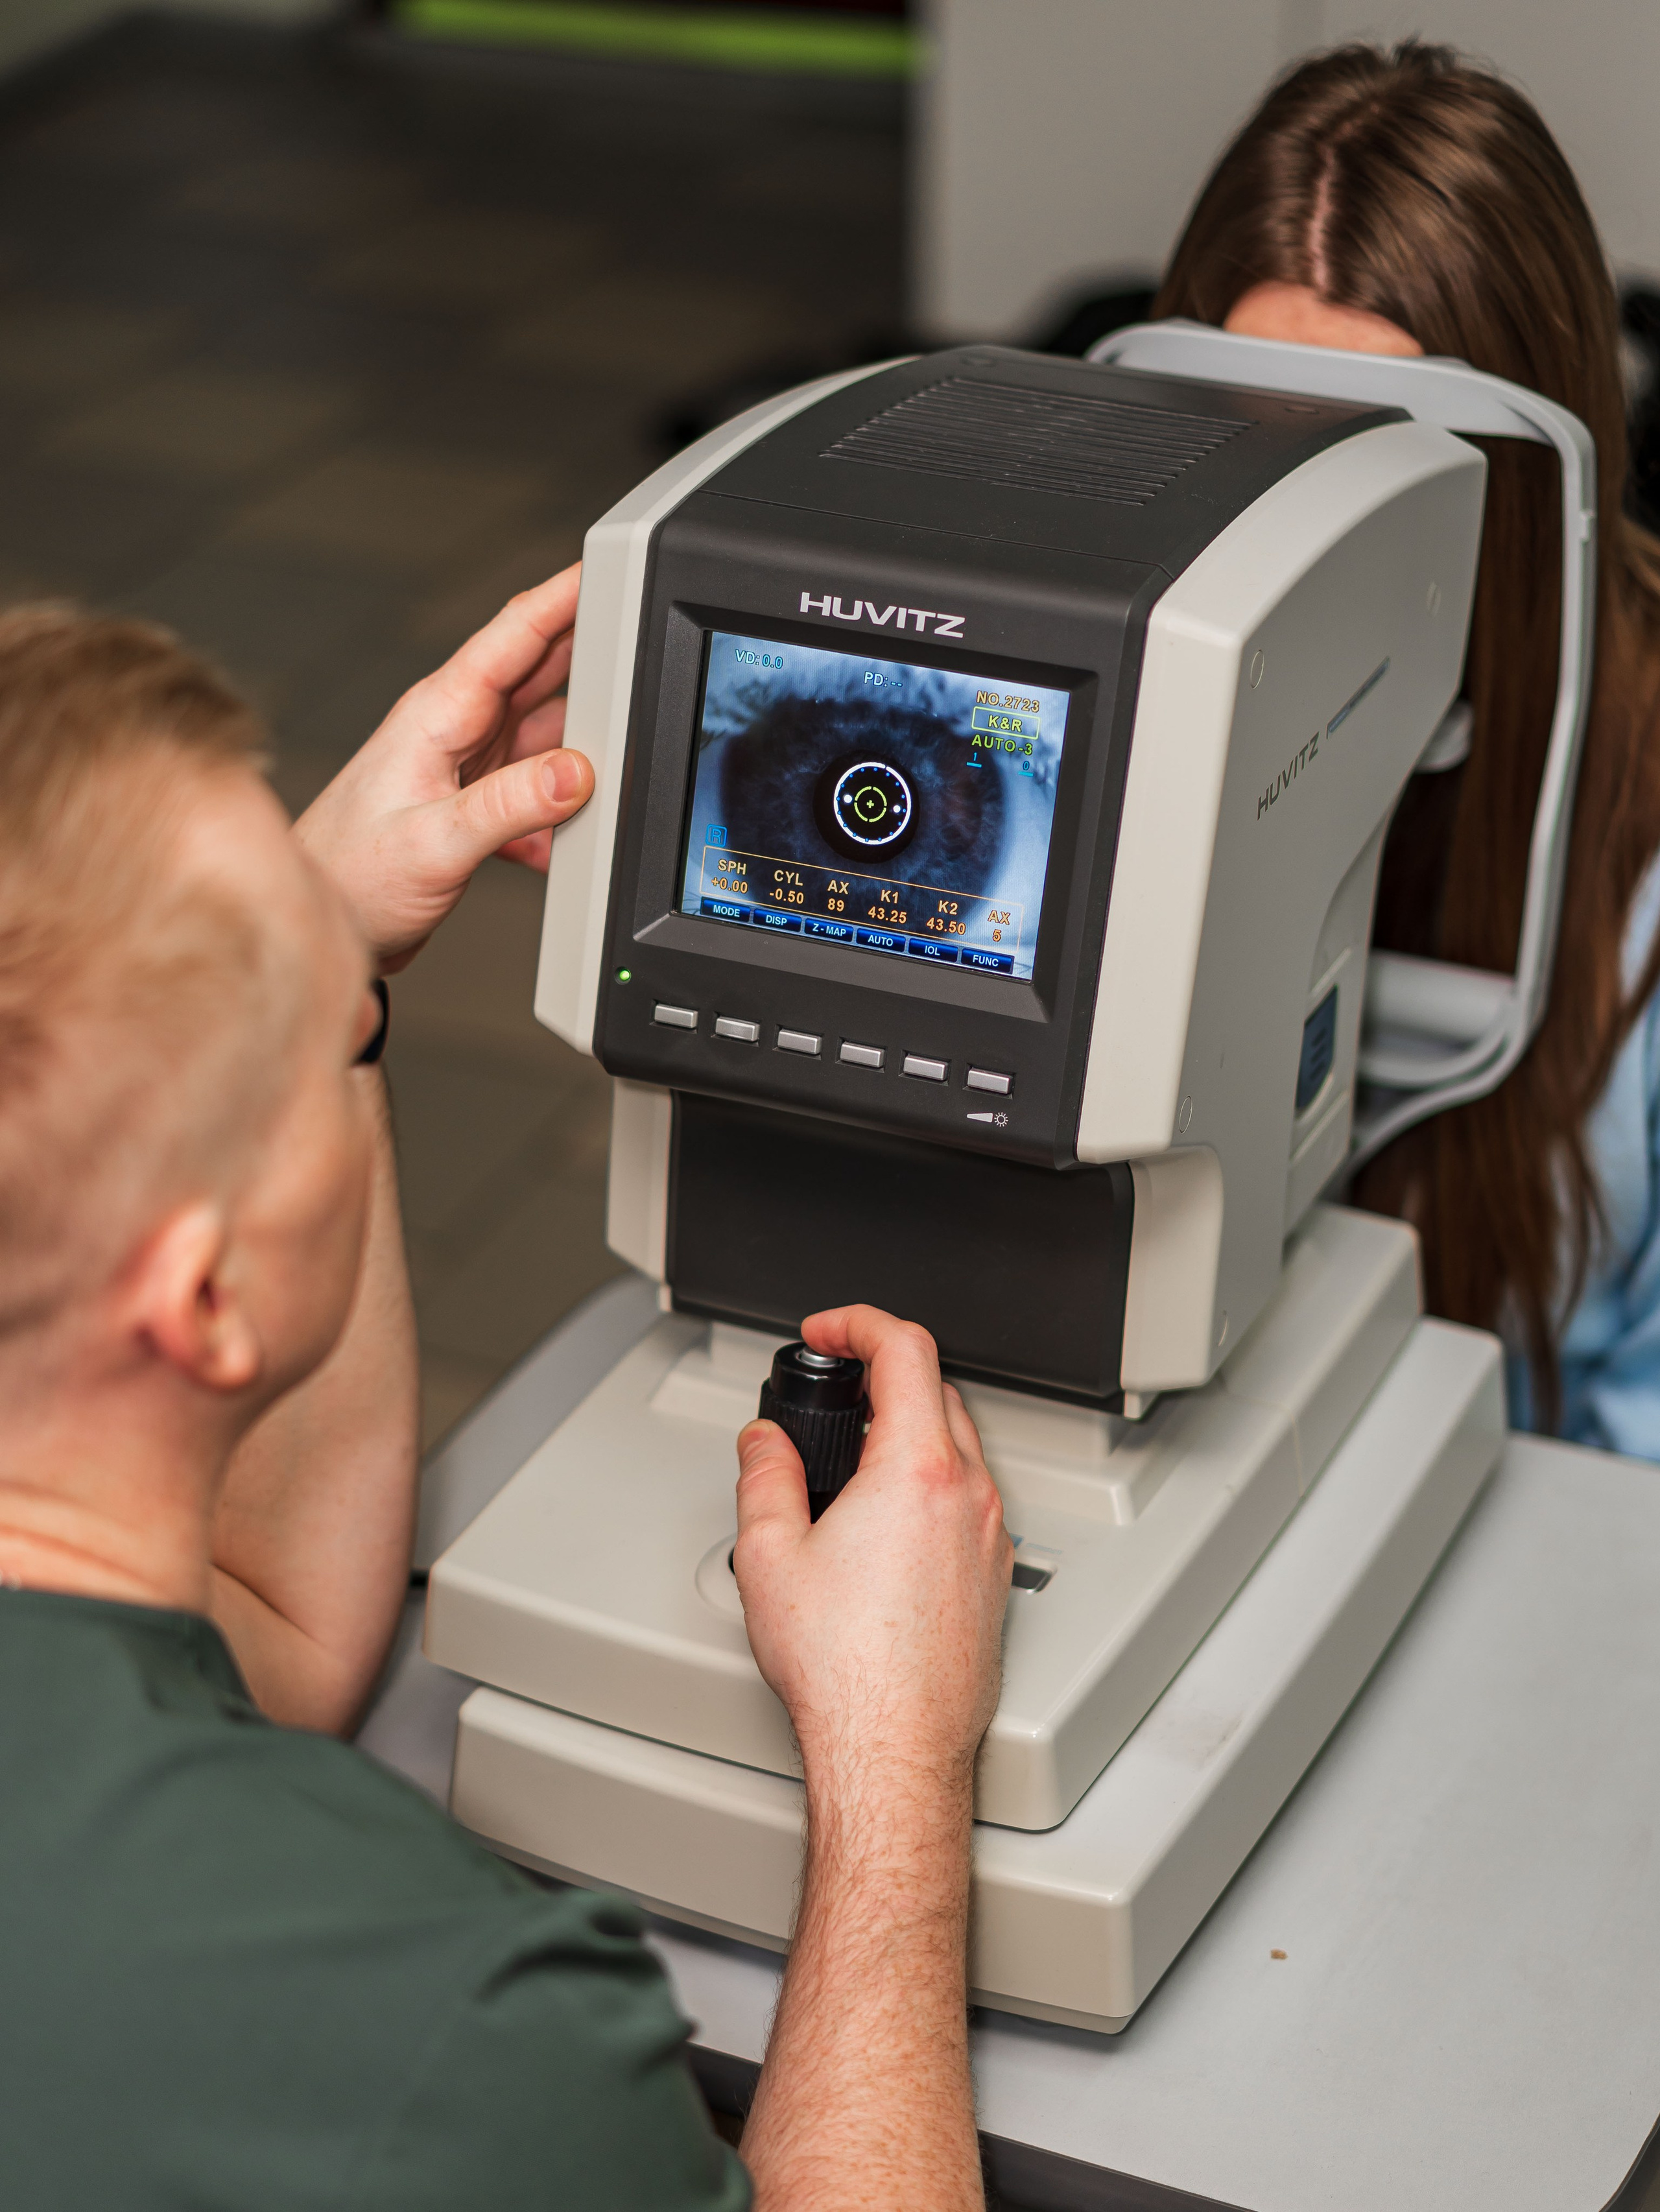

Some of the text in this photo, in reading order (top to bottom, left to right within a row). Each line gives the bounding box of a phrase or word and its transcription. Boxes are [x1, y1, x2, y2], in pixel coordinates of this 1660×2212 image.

[800, 592, 966, 638] HUVITZ
[976, 690, 1040, 713] NO.2723
[988, 715, 1023, 733] K&R
[1257, 731, 1320, 820] HUVITZ
[711, 877, 1002, 942] +0.00 -0.50 89 43.25 43.50 5
[718, 859, 1011, 925] SPH CYL AX K1 K2 AX
[713, 905, 741, 918] MODE
[765, 914, 787, 926] DISP
[868, 934, 893, 946] AUTO
[924, 945, 940, 956] IOL
[972, 955, 999, 967] FUNC
